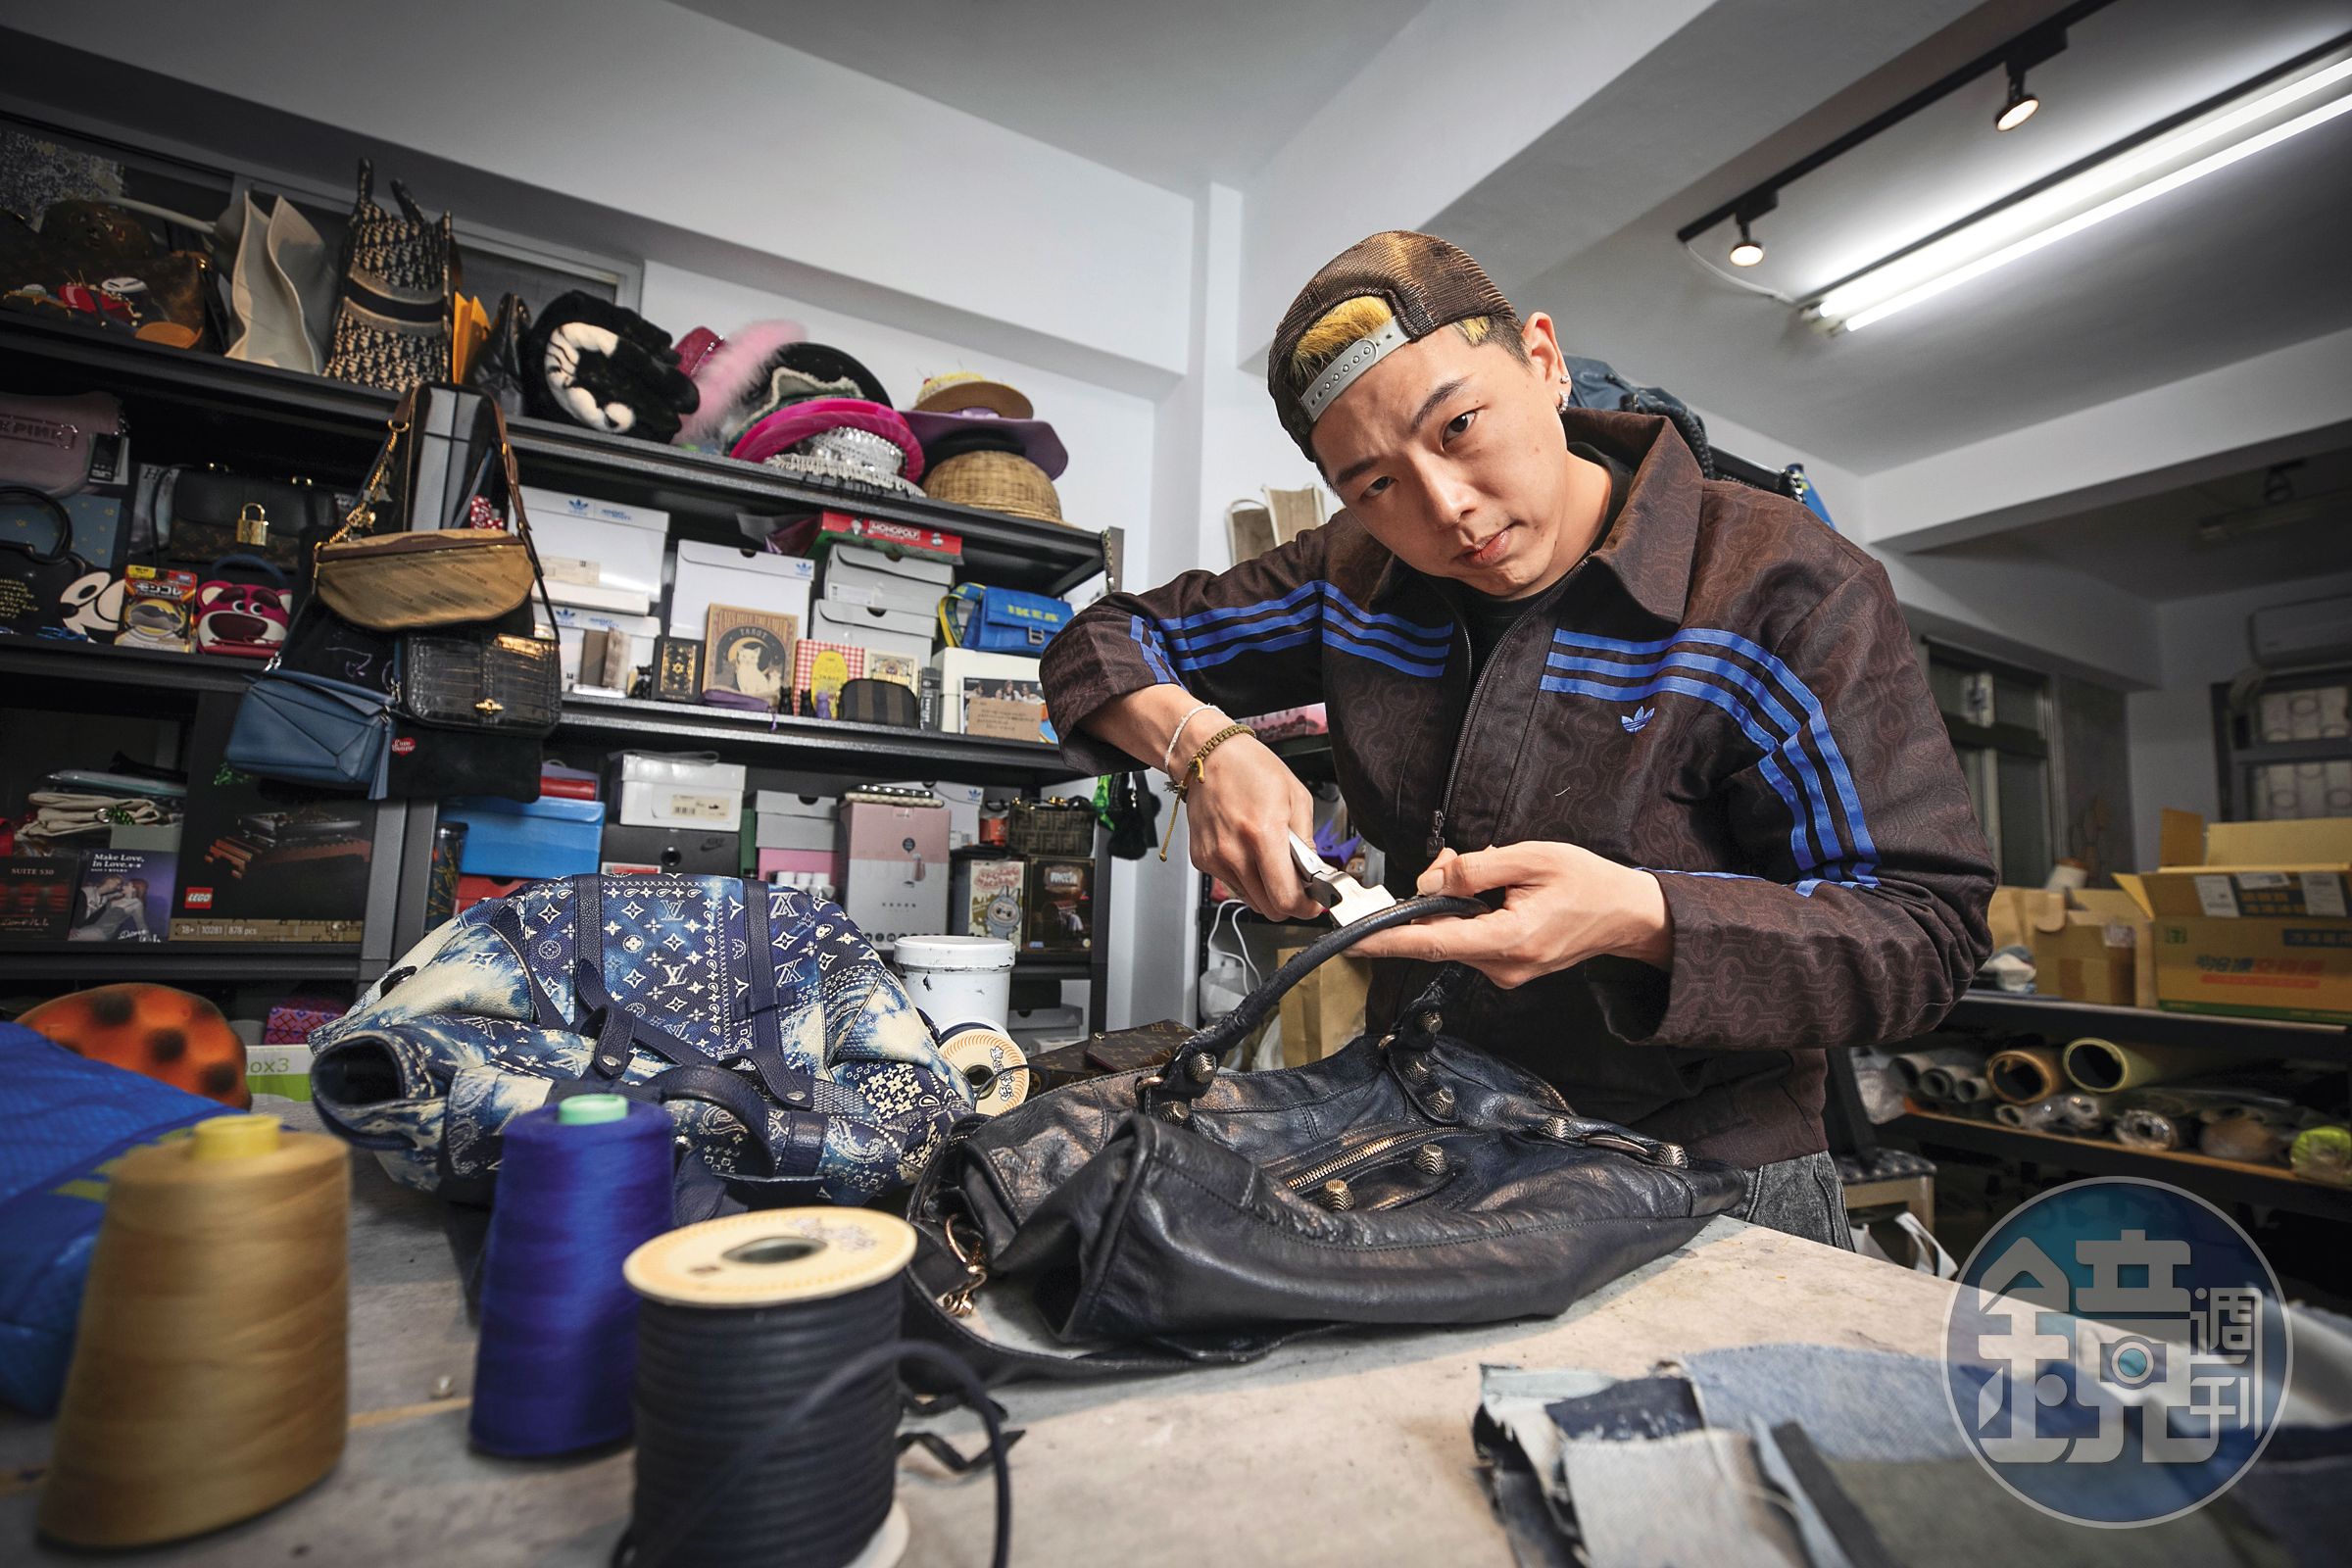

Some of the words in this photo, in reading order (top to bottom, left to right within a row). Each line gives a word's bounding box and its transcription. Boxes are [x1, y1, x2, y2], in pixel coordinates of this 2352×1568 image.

[871, 523, 917, 539] MONOPOLY
[1007, 604, 1058, 622] IKEA
[740, 628, 769, 639] TAROT
[120, 854, 145, 862] Love,
[187, 893, 213, 903] LEGO
[181, 925, 195, 934] 18+
[246, 1057, 289, 1074] ox3
